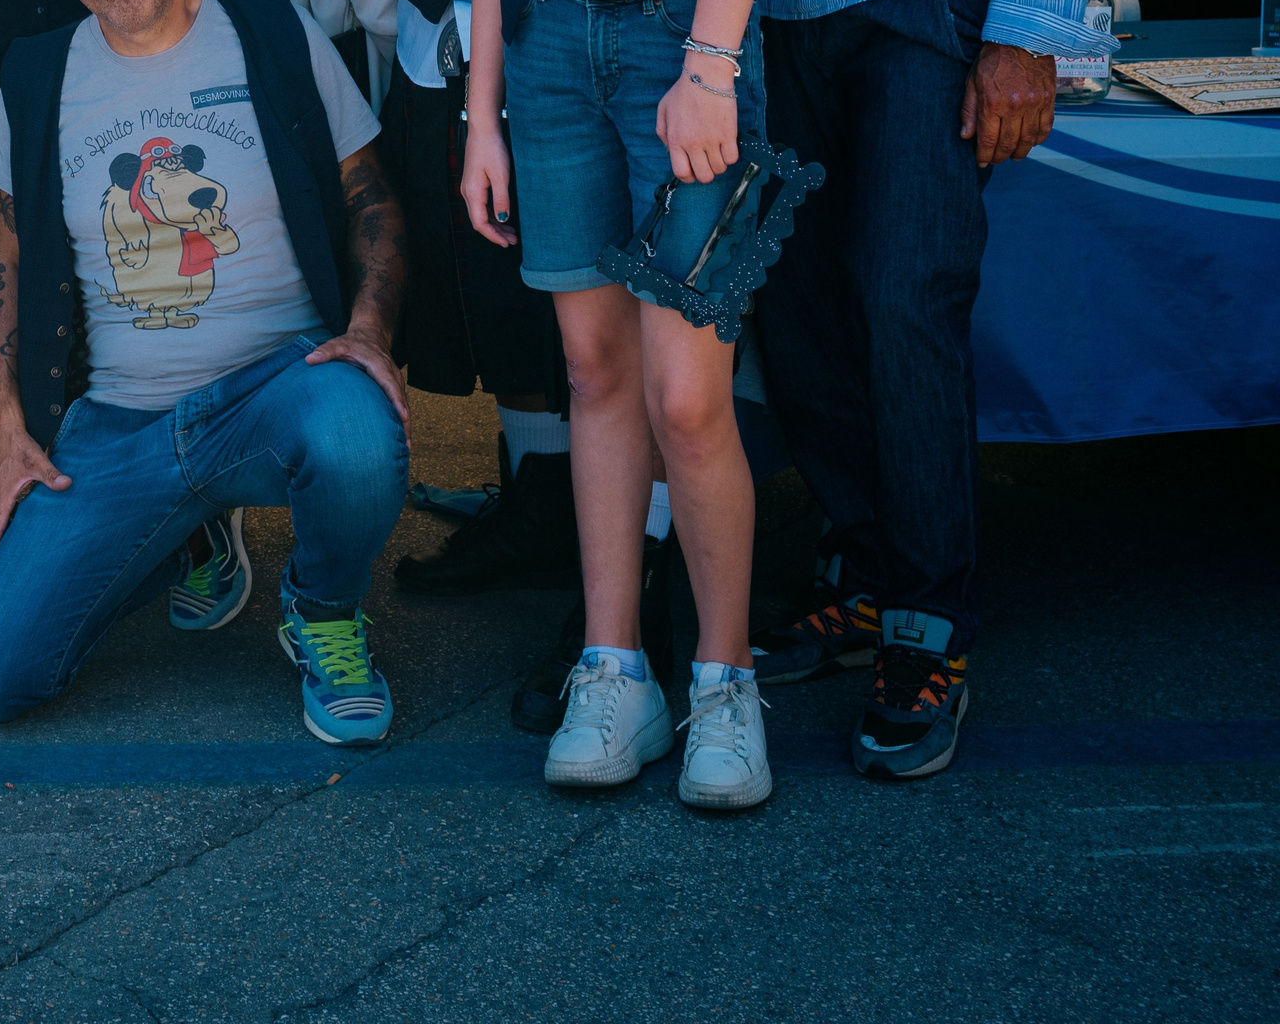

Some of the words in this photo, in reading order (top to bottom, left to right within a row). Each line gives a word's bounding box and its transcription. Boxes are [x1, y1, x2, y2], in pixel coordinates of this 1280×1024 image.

[192, 89, 251, 105] DESMOVINIX
[64, 154, 86, 178] Lo
[84, 118, 135, 157] Spirito
[139, 106, 257, 150] Motociclistico
